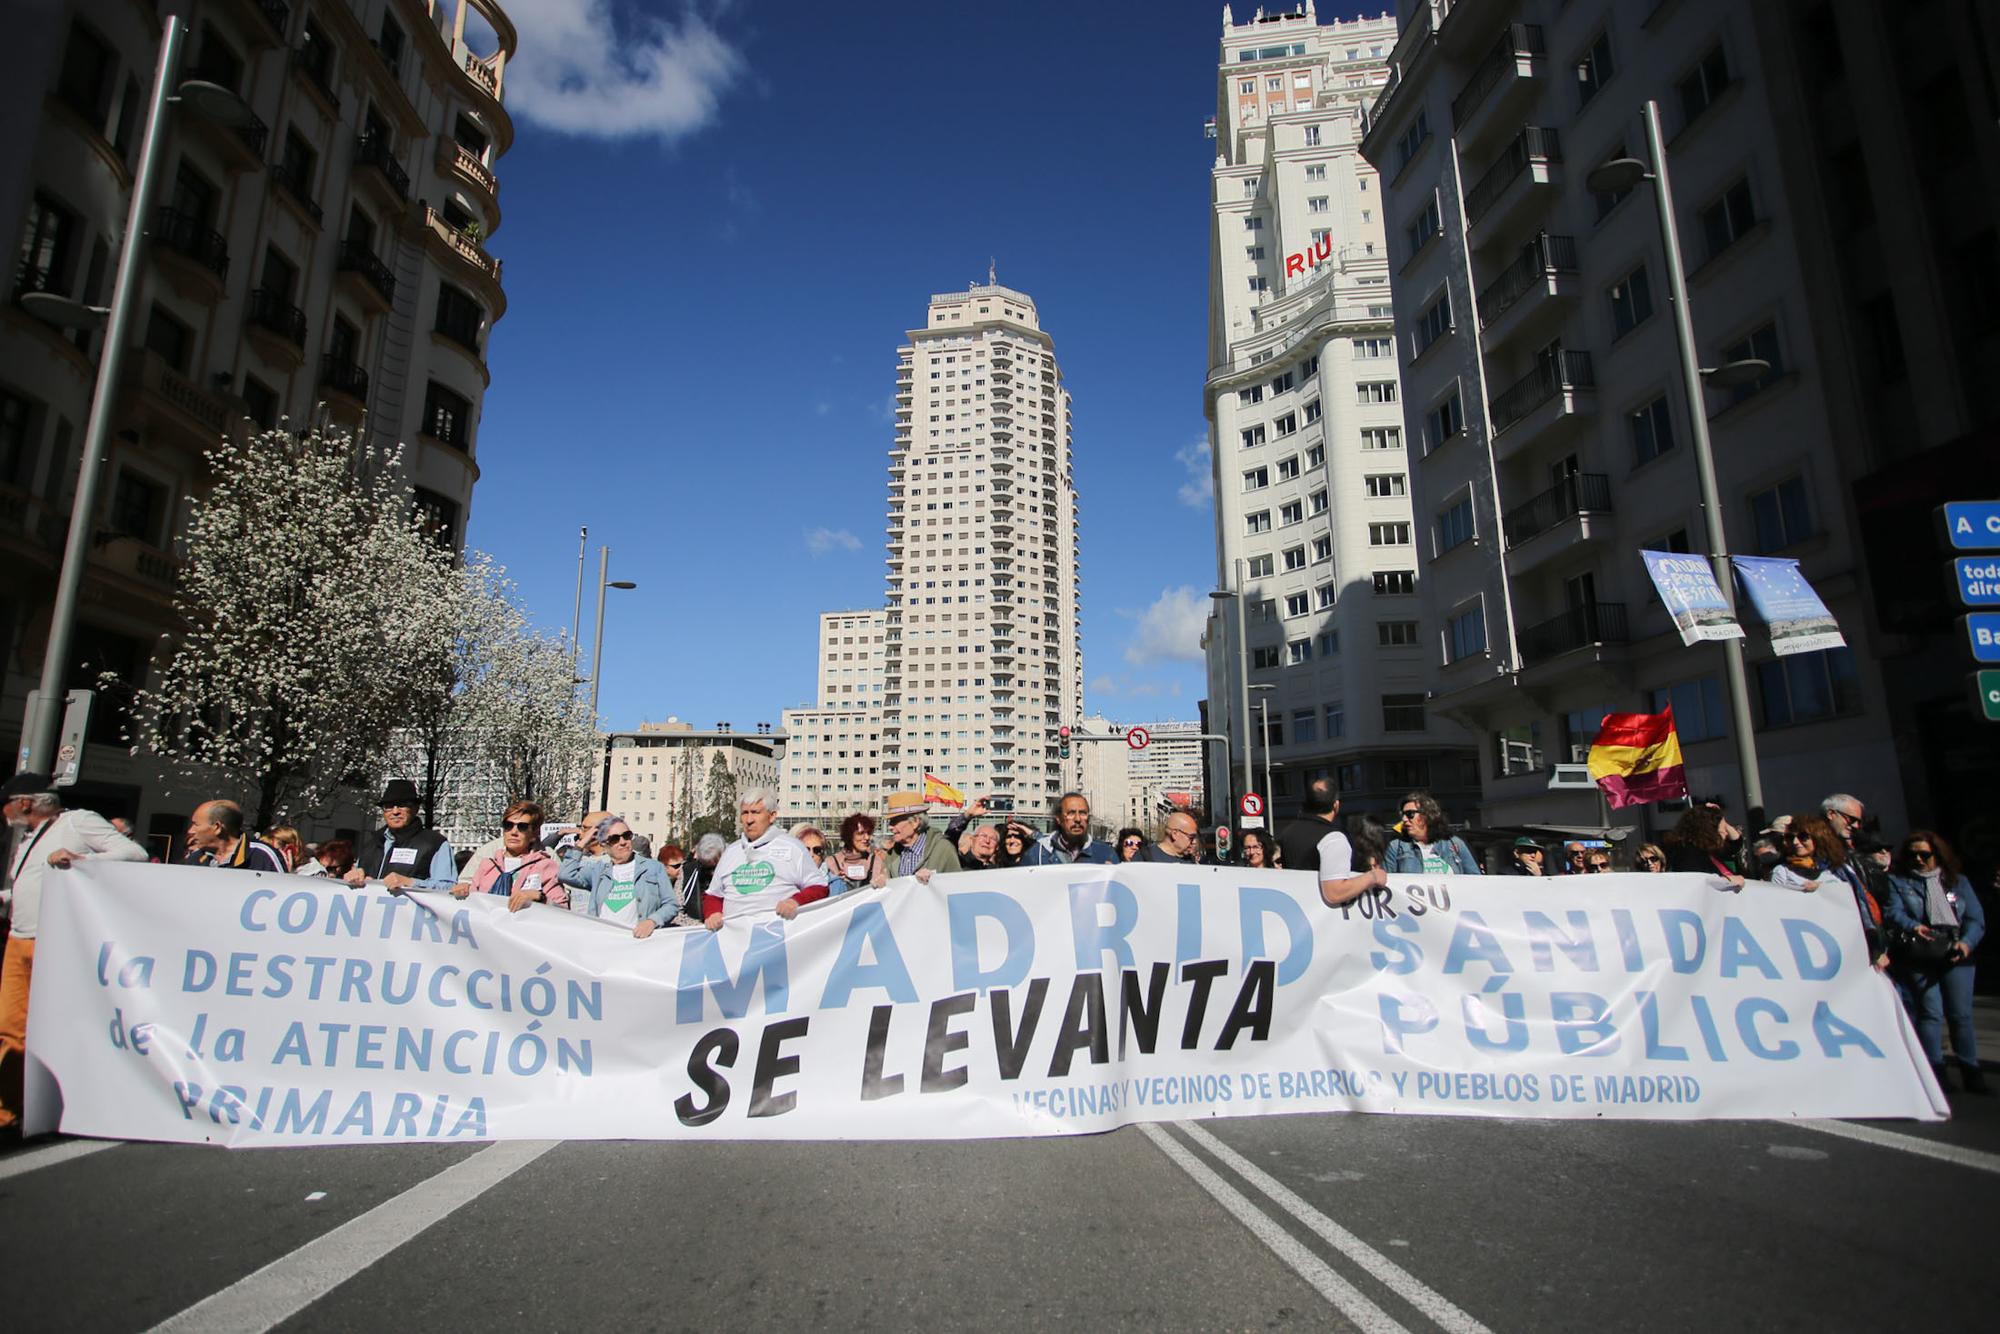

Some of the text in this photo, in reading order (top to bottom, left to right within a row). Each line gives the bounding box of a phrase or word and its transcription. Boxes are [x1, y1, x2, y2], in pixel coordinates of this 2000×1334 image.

[1286, 232, 1332, 278] RIU
[1956, 516, 1973, 534] A
[239, 889, 478, 949] CONTRA
[1405, 884, 1451, 917] SU
[676, 880, 1313, 1024] MADRID
[1370, 908, 1843, 982] SANIDAD
[97, 941, 602, 1021] la DESTRUCCIÓN
[109, 1008, 593, 1077] de la ATENCIÓN
[673, 960, 1275, 1127] SE LEVANTA
[1378, 974, 1886, 1063] PÚBLICA
[172, 1081, 487, 1137] PRIMARIA
[1013, 1069, 1701, 1118] VECINAS Y VECINOS DE BARRIOS Y PUEBLOS DE MADRID
